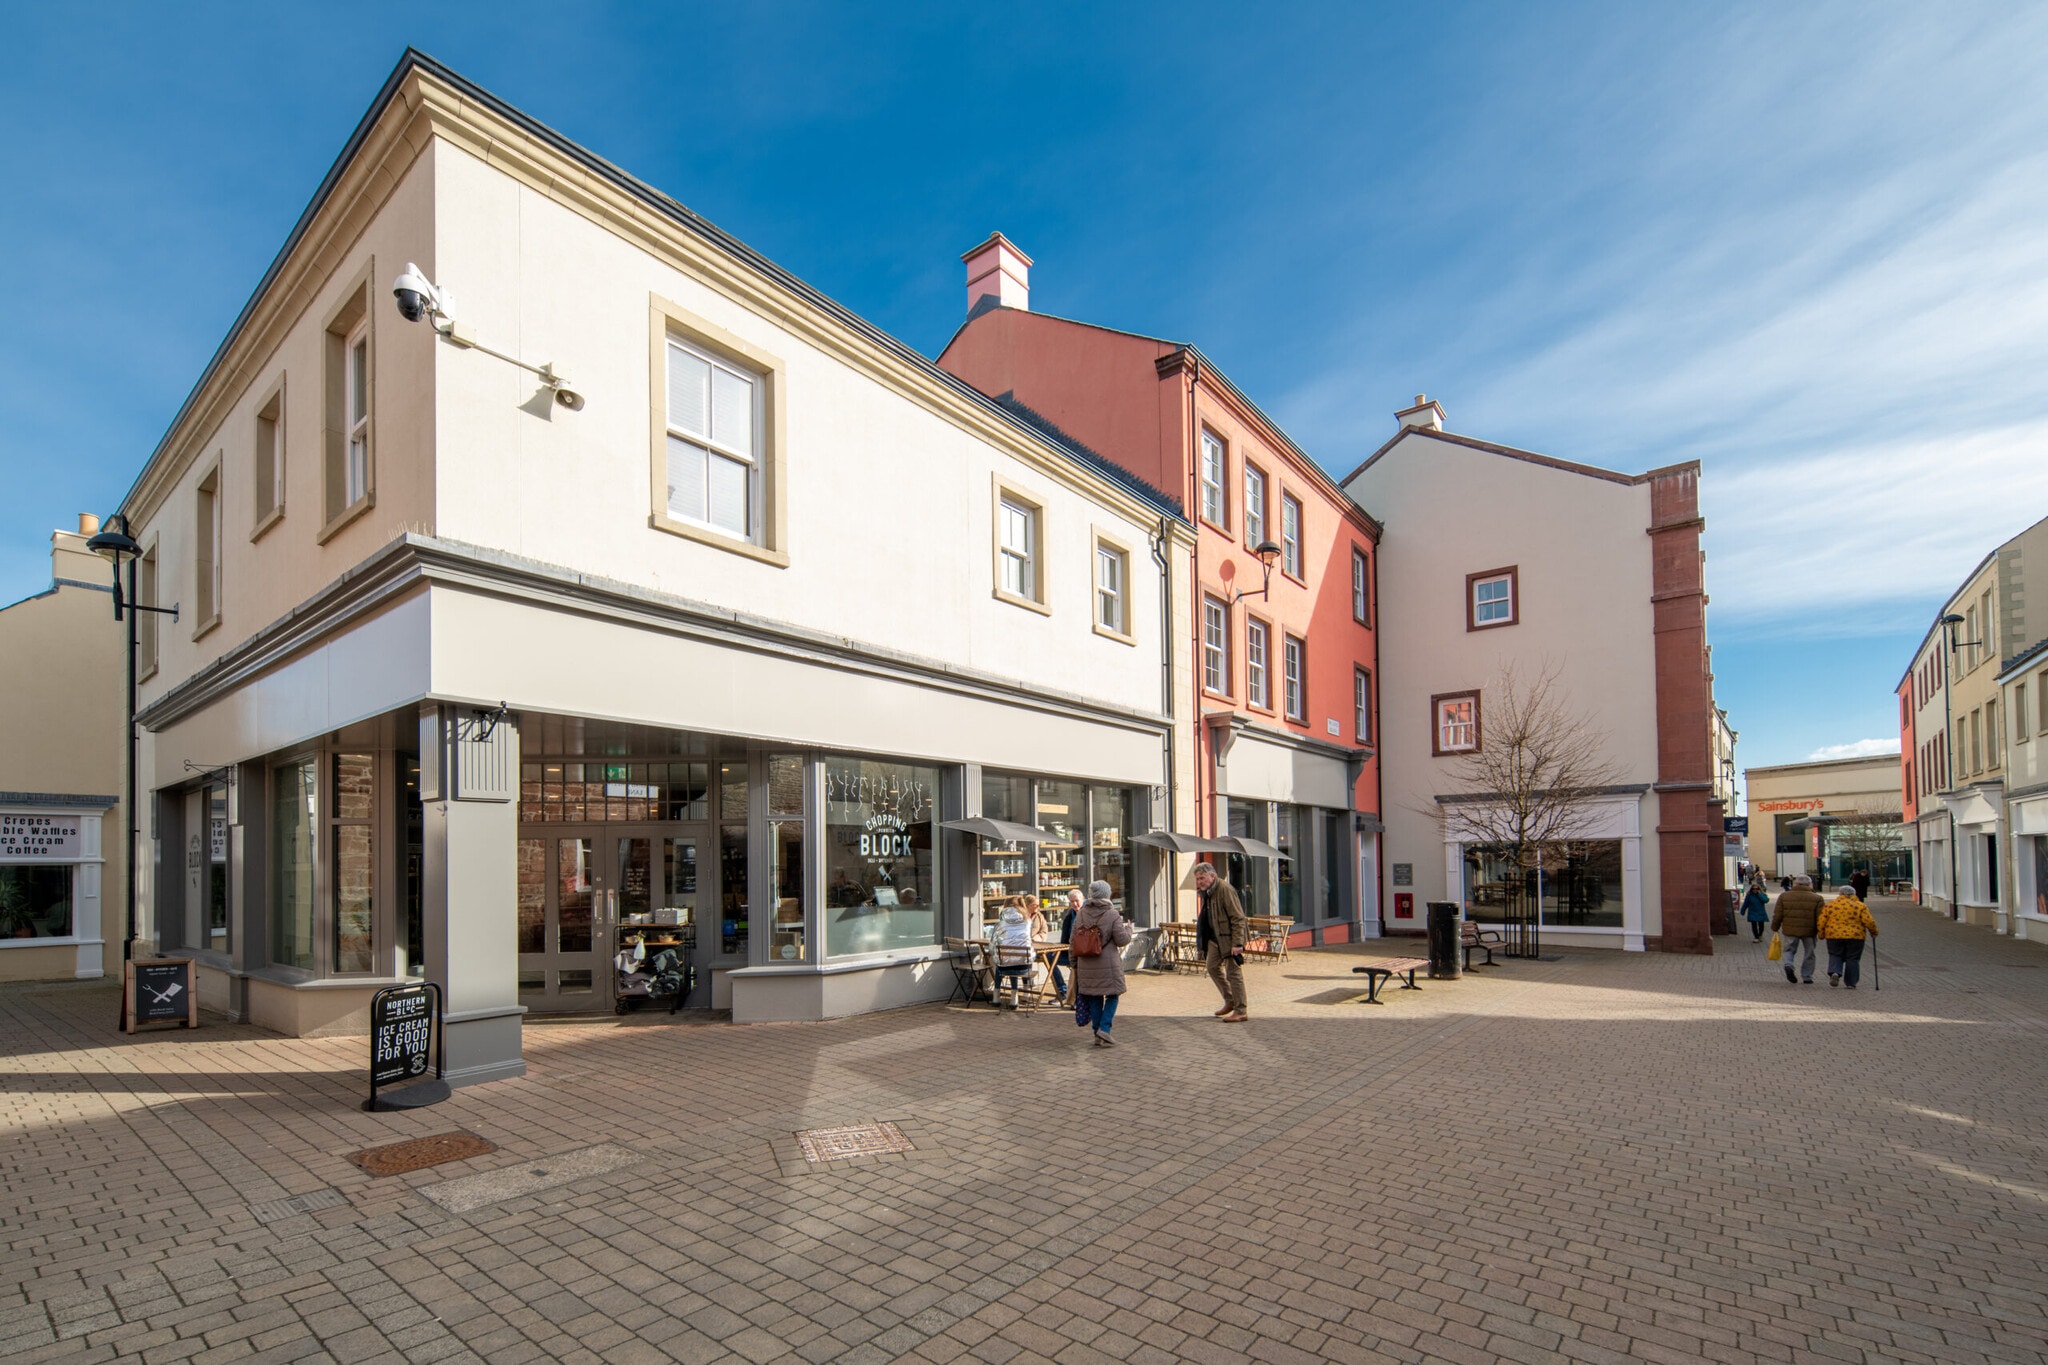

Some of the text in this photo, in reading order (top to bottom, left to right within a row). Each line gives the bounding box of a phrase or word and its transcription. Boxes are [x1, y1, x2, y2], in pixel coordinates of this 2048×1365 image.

[1757, 798, 1824, 812] Sainsbury's
[4, 816, 51, 826] Crepes
[865, 814, 907, 832] CHOPPING
[31, 826, 76, 835] Waffles
[23, 836, 64, 845] Cream
[860, 834, 912, 856] BLOCK
[7, 846, 48, 854] Coffee
[386, 996, 426, 1011] NORTHERN
[379, 1017, 429, 1036] ICE CREAM
[378, 1027, 428, 1050] IS GOOD
[377, 1039, 427, 1063] FOR YOU
